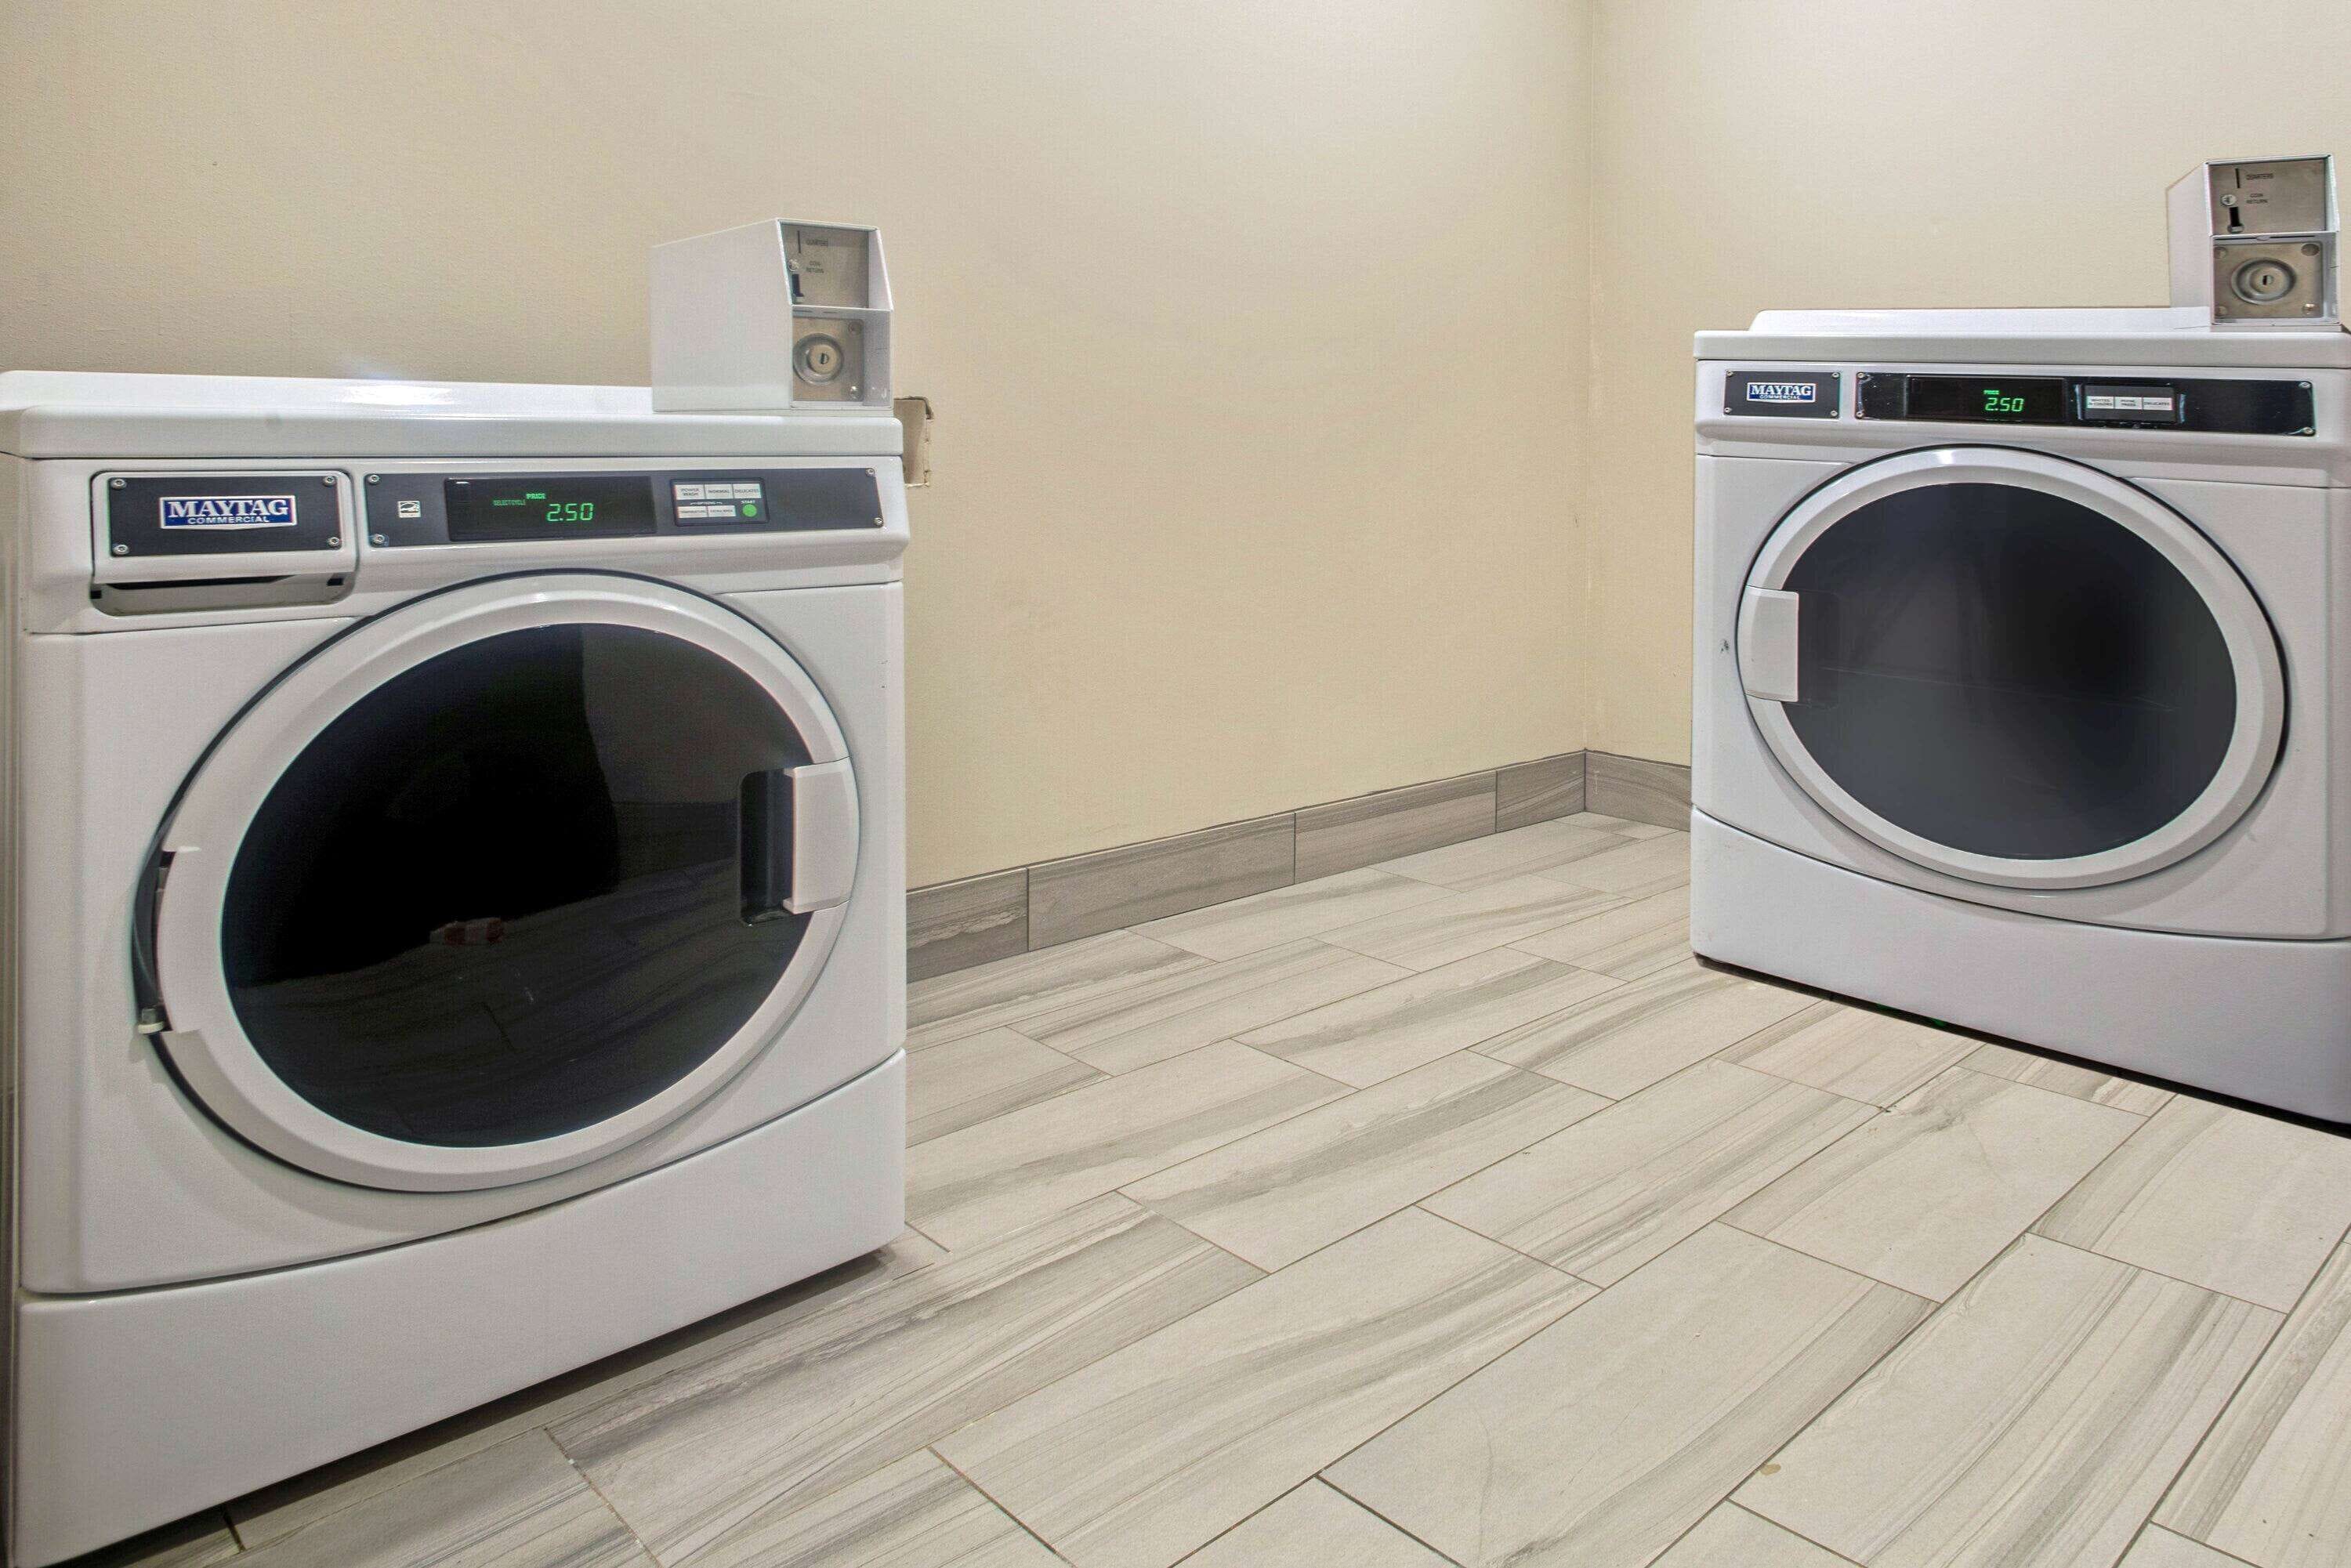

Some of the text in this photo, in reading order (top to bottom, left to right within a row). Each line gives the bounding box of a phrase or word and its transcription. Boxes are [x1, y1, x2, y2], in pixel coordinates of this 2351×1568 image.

[1751, 385, 1812, 396] MAYTAG
[1985, 397, 2024, 412] 2.50
[168, 500, 288, 518] MAYTAG
[546, 502, 594, 522] 2.50
[187, 516, 270, 525] COMMERCIAL
